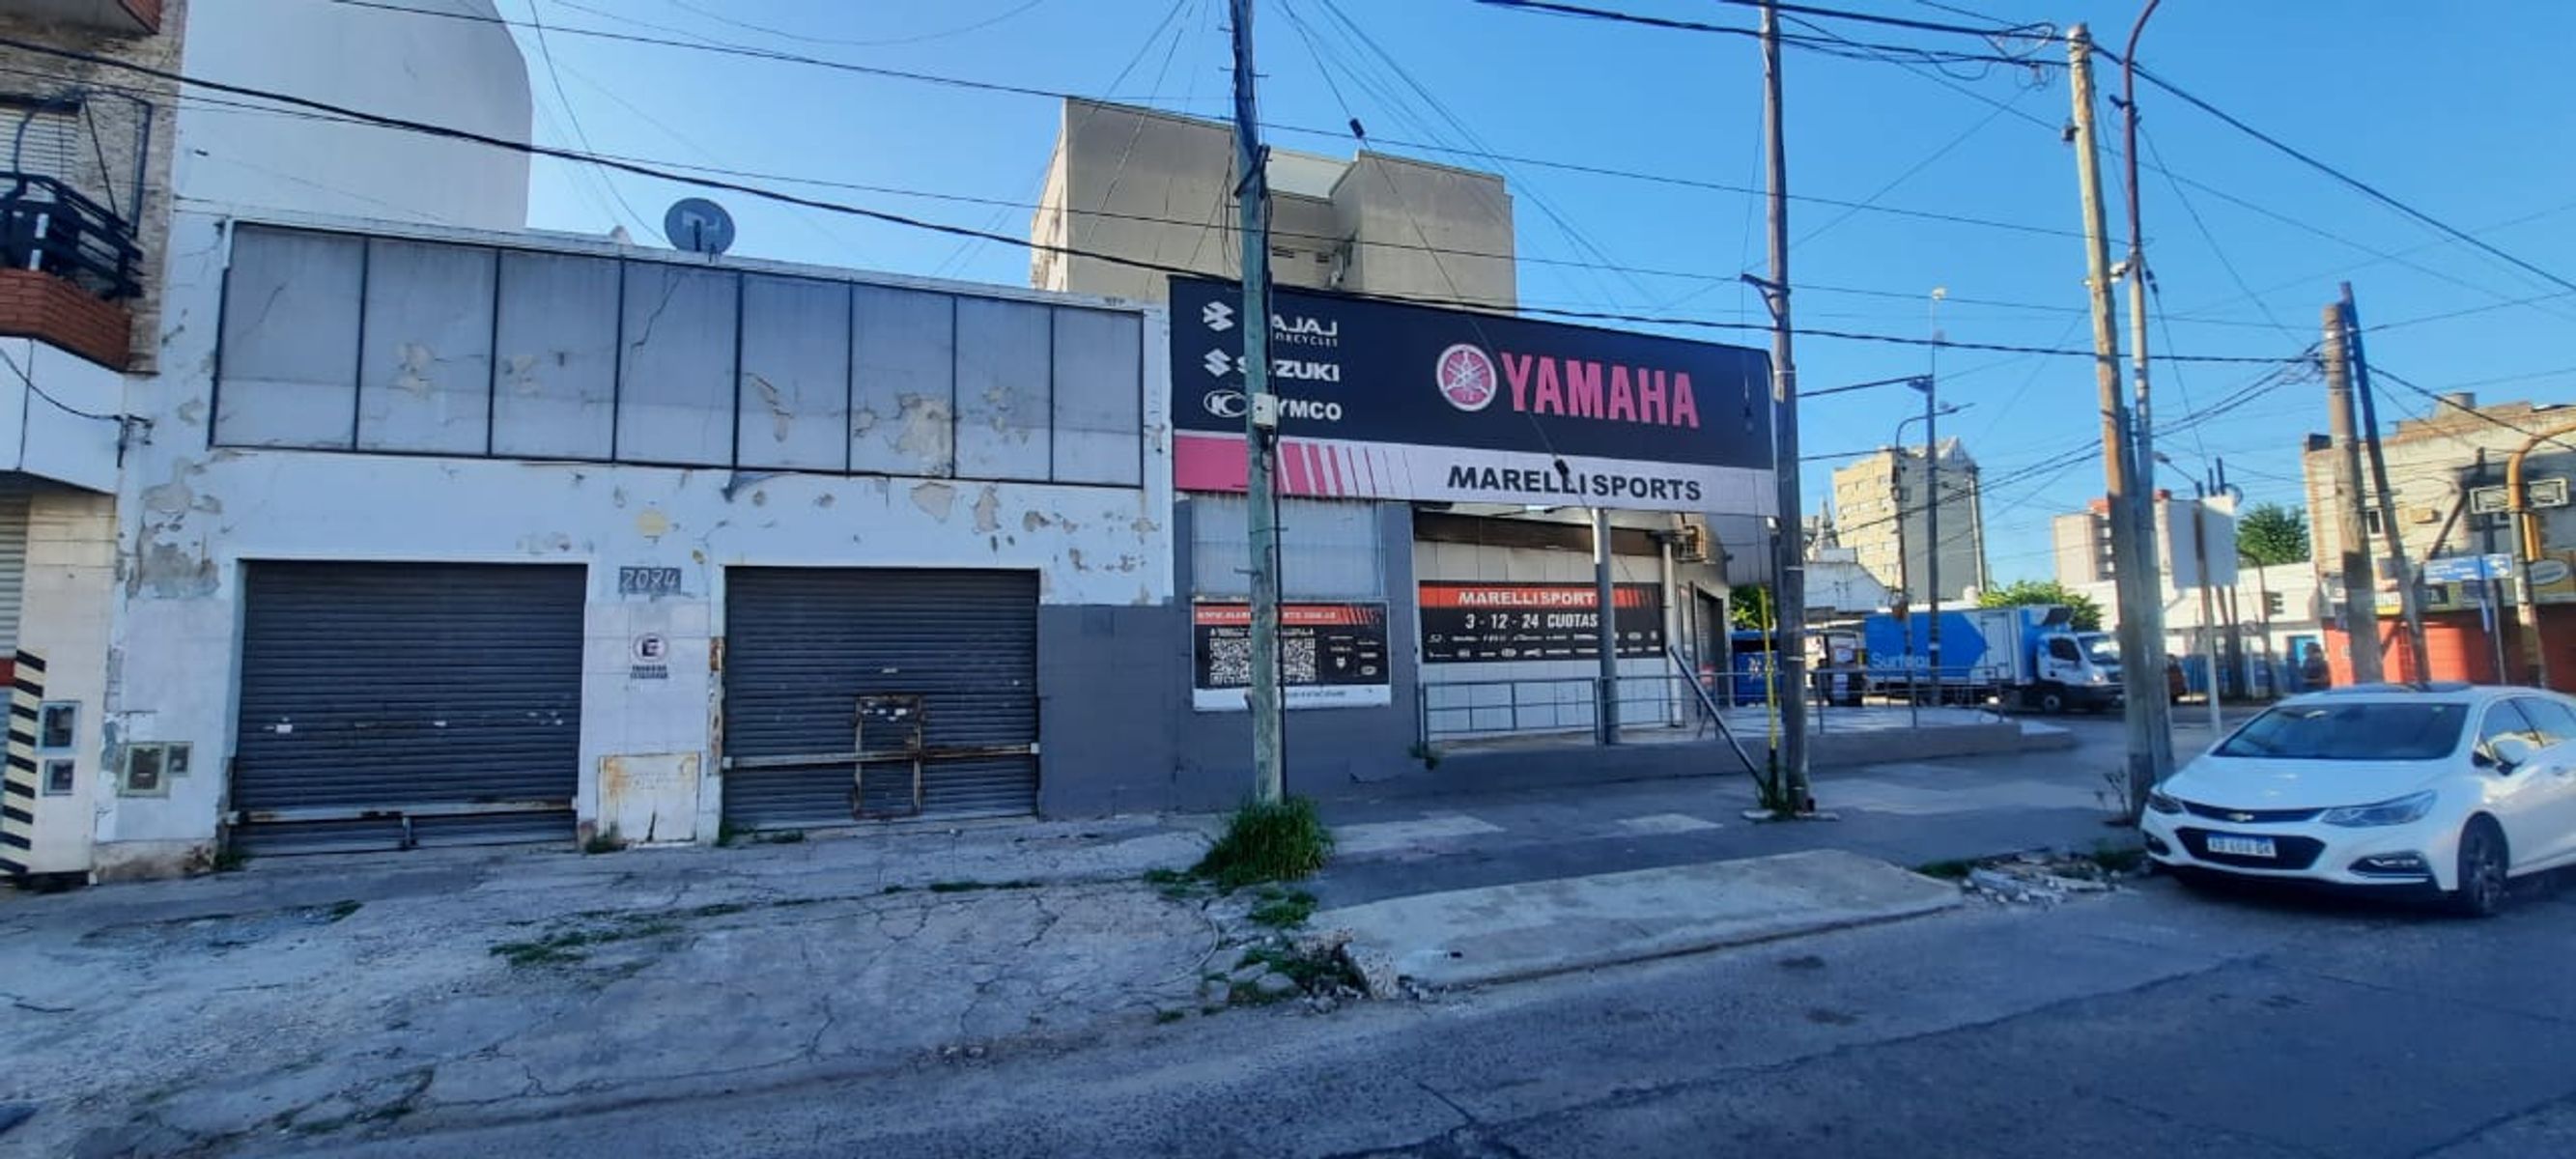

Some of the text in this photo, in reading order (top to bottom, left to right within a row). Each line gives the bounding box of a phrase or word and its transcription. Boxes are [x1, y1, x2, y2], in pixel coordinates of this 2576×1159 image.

[1272, 314, 1338, 336] AJAJ
[1500, 352, 1699, 428] YAMAHA
[1278, 398, 1343, 421] YMCO
[1465, 613, 1475, 629] 3
[1490, 614, 1507, 629] 12
[1522, 613, 1539, 629] 24
[1546, 613, 1599, 629] CUOTAS
